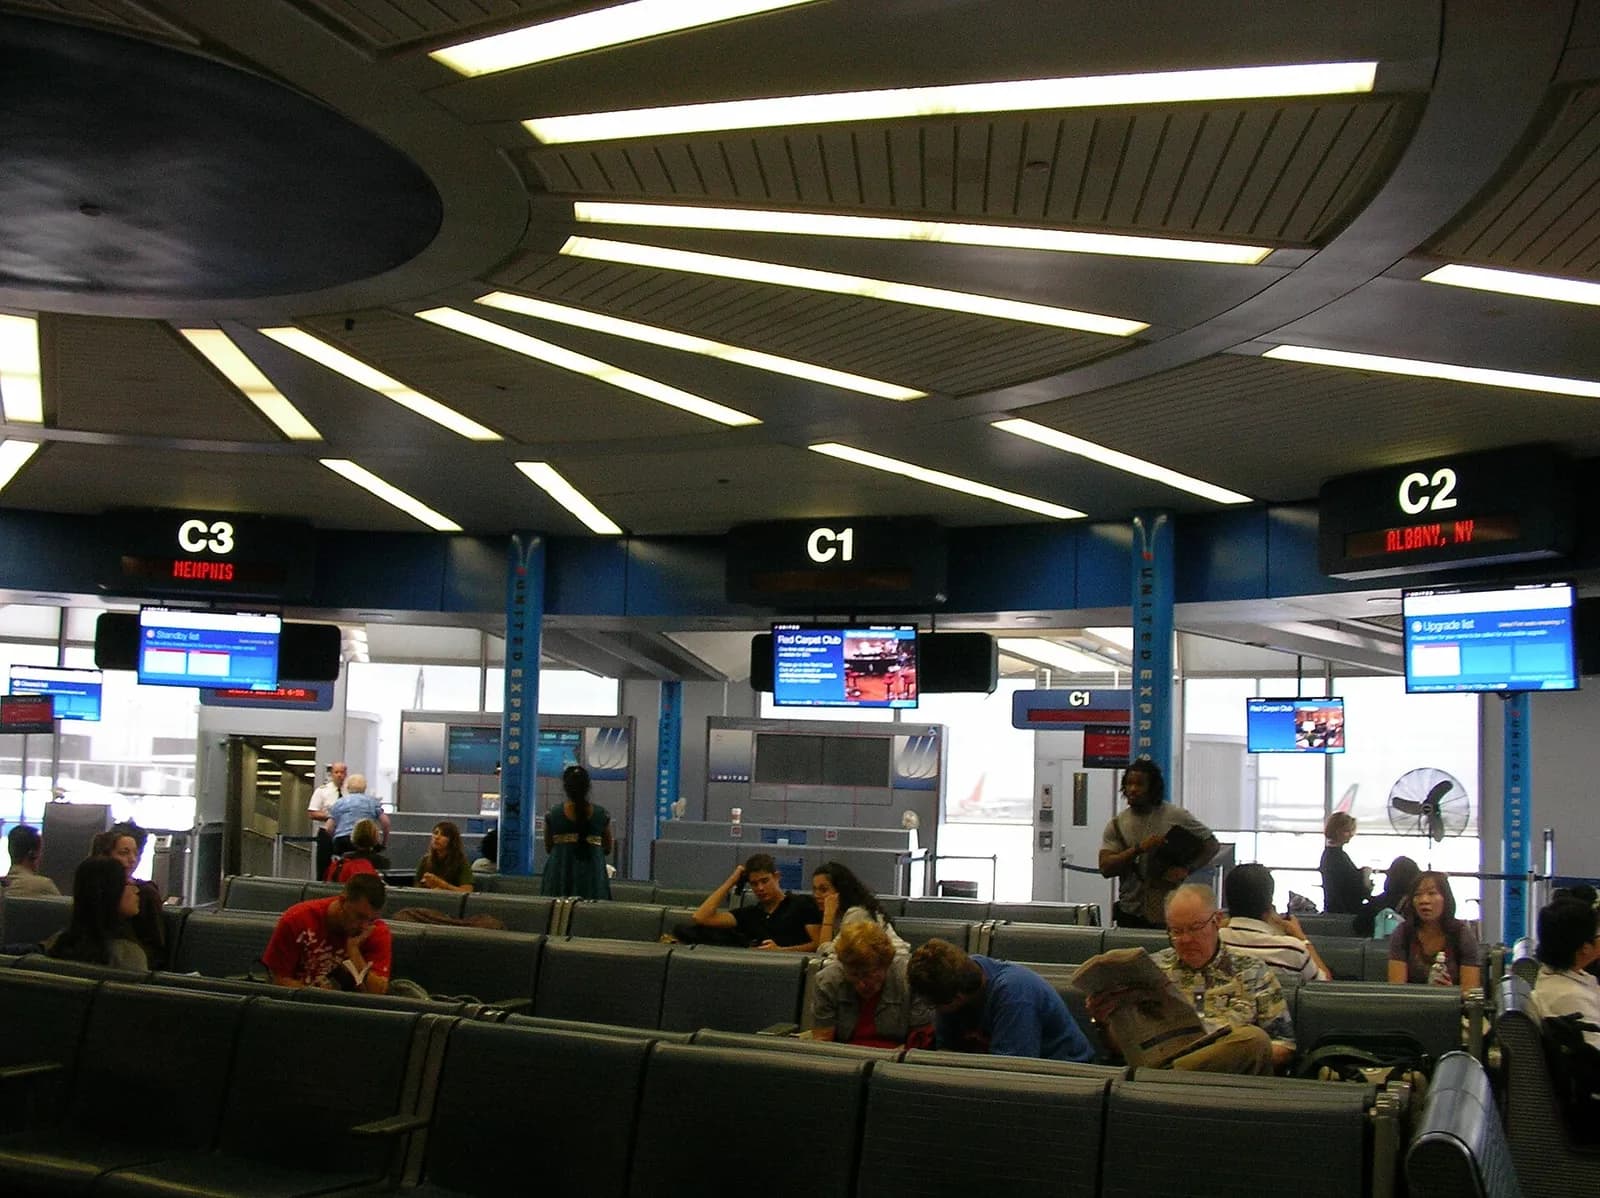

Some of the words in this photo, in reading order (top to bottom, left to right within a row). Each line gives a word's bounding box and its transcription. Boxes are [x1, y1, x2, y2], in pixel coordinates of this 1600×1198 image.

[1399, 468, 1457, 514] C2
[178, 519, 234, 554] C3
[807, 527, 853, 563] C1
[1386, 523, 1446, 551] ALBANY,
[1454, 519, 1474, 543] NY
[173, 560, 233, 580] MEMPHIS
[512, 580, 526, 662] UNITED
[1141, 568, 1153, 660] UNITED
[1423, 621, 1460, 633] Upgrade
[1462, 619, 1475, 629] list
[156, 630, 188, 641] Standby
[778, 635, 795, 644] Red
[795, 635, 821, 646] Carpet
[822, 635, 842, 645] Club
[1069, 691, 1090, 706] C1
[508, 669, 523, 765] EXPRESS
[1511, 720, 1521, 781] UNITED
[1511, 786, 1521, 860] EXPRESS
